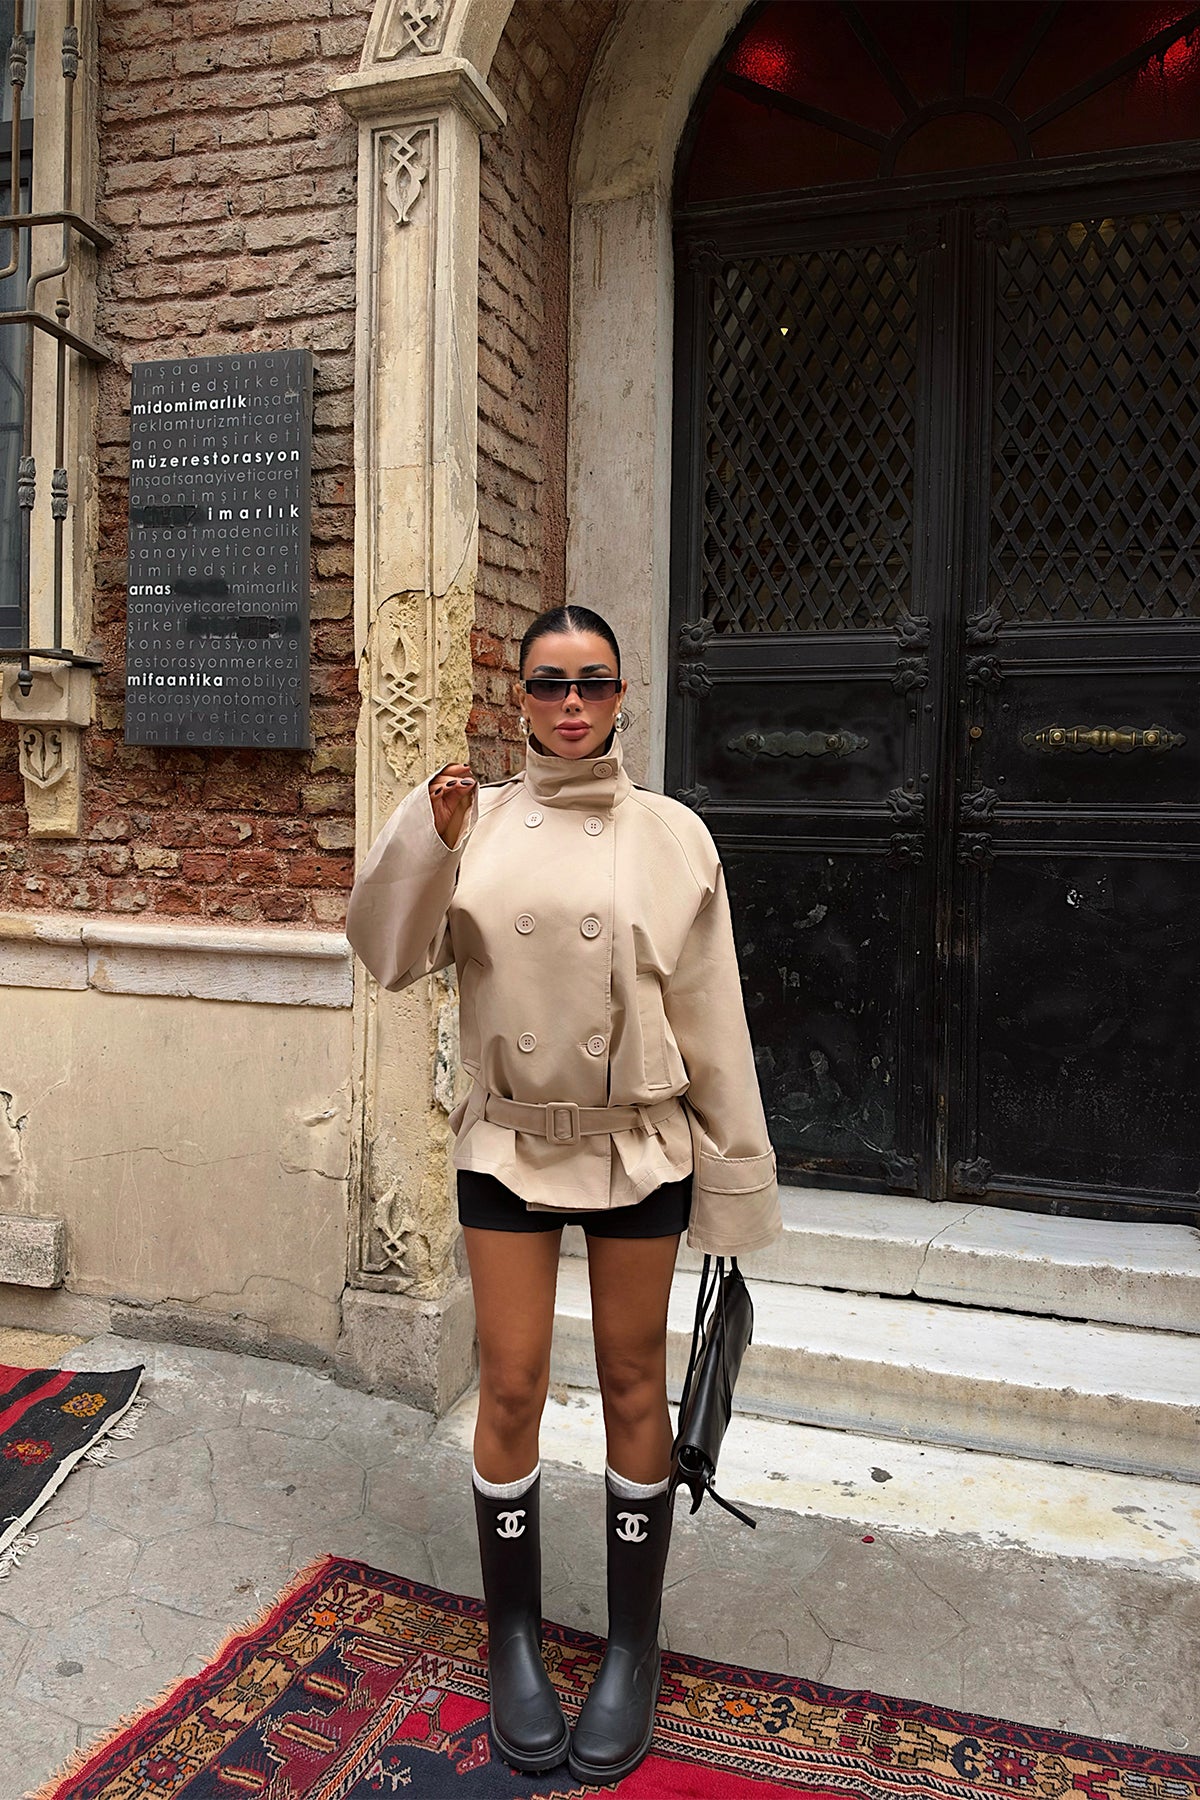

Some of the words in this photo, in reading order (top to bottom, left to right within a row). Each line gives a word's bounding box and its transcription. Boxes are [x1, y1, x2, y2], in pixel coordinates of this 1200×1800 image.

[133, 371, 300, 397] limitedşirketi
[132, 411, 300, 433] reklamturizmticaret
[132, 428, 300, 451] anonimşirketi
[131, 450, 300, 470] müzerestorasyon
[131, 466, 300, 489] inşaatsanayiveticaret
[131, 484, 300, 505] anonimşirketi
[130, 523, 299, 543] inşaatmadencilik
[129, 543, 299, 561] sanayiveticaret
[129, 561, 299, 578] limitedşirketi
[129, 584, 172, 596] arnas
[128, 598, 298, 616] sanayiveticaretanonim
[128, 636, 298, 652] konservasyonve
[127, 655, 298, 671] restorasyonmerkezi
[127, 691, 299, 707] dekorasyonotomotiv
[126, 709, 298, 725] sanayiveticaret
[125, 727, 299, 744] limitedşirketi
